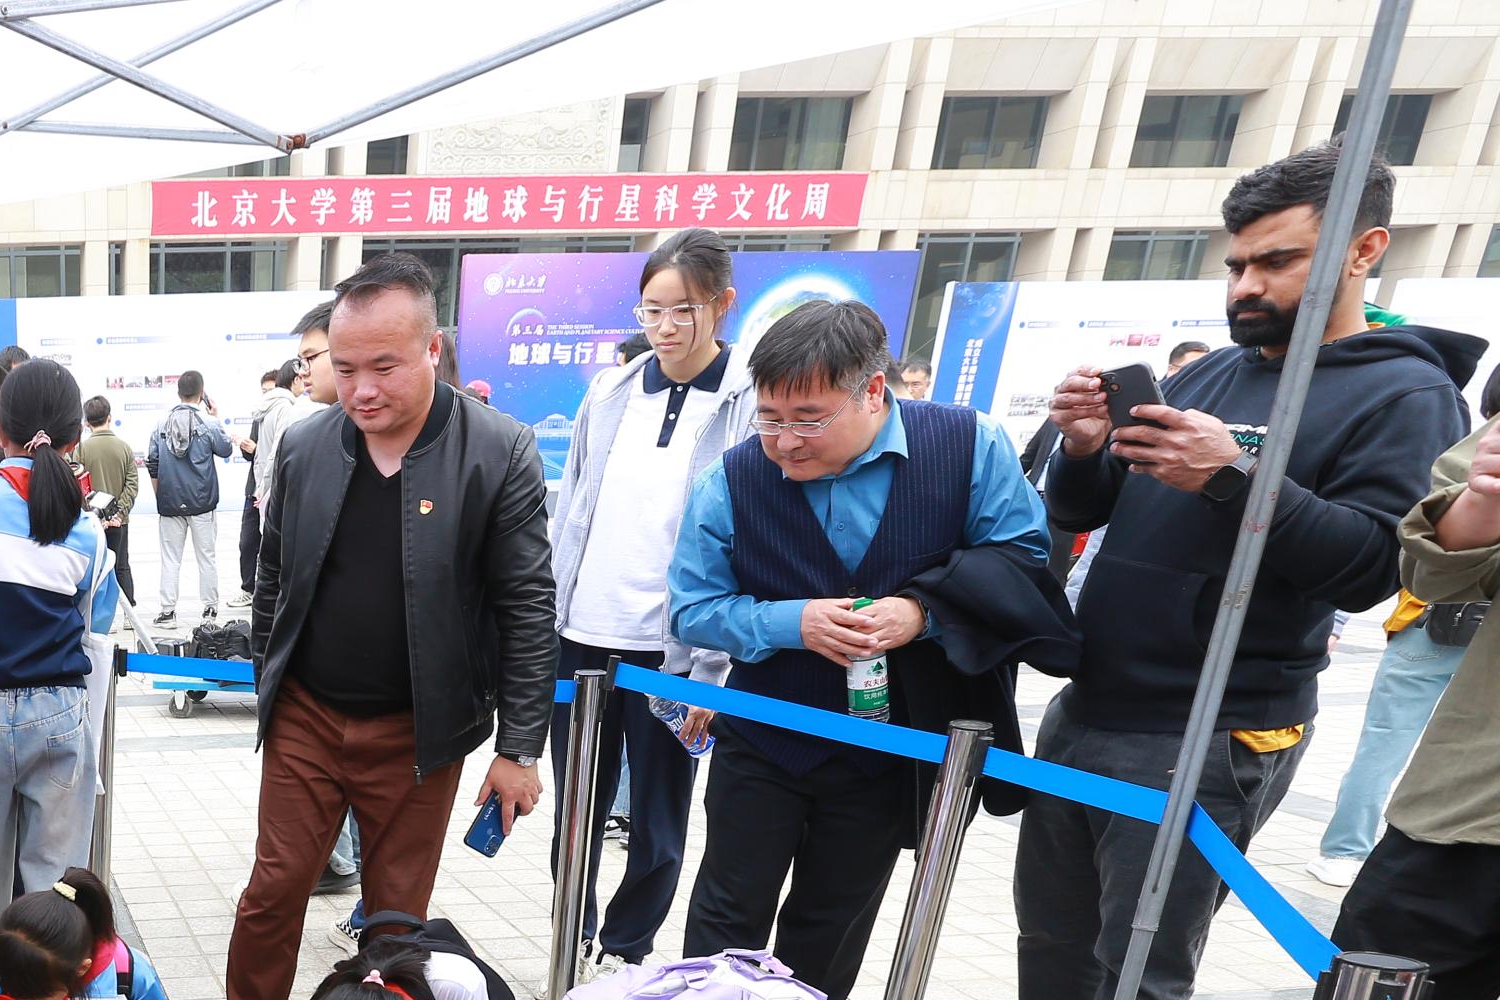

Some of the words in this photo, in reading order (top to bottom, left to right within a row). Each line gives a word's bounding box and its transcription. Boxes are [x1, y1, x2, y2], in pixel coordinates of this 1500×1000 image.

[190, 181, 831, 228] 北京大学第三届地球与行星科学文化周
[511, 324, 544, 337] 第三届
[507, 342, 622, 365] 地球与行星
